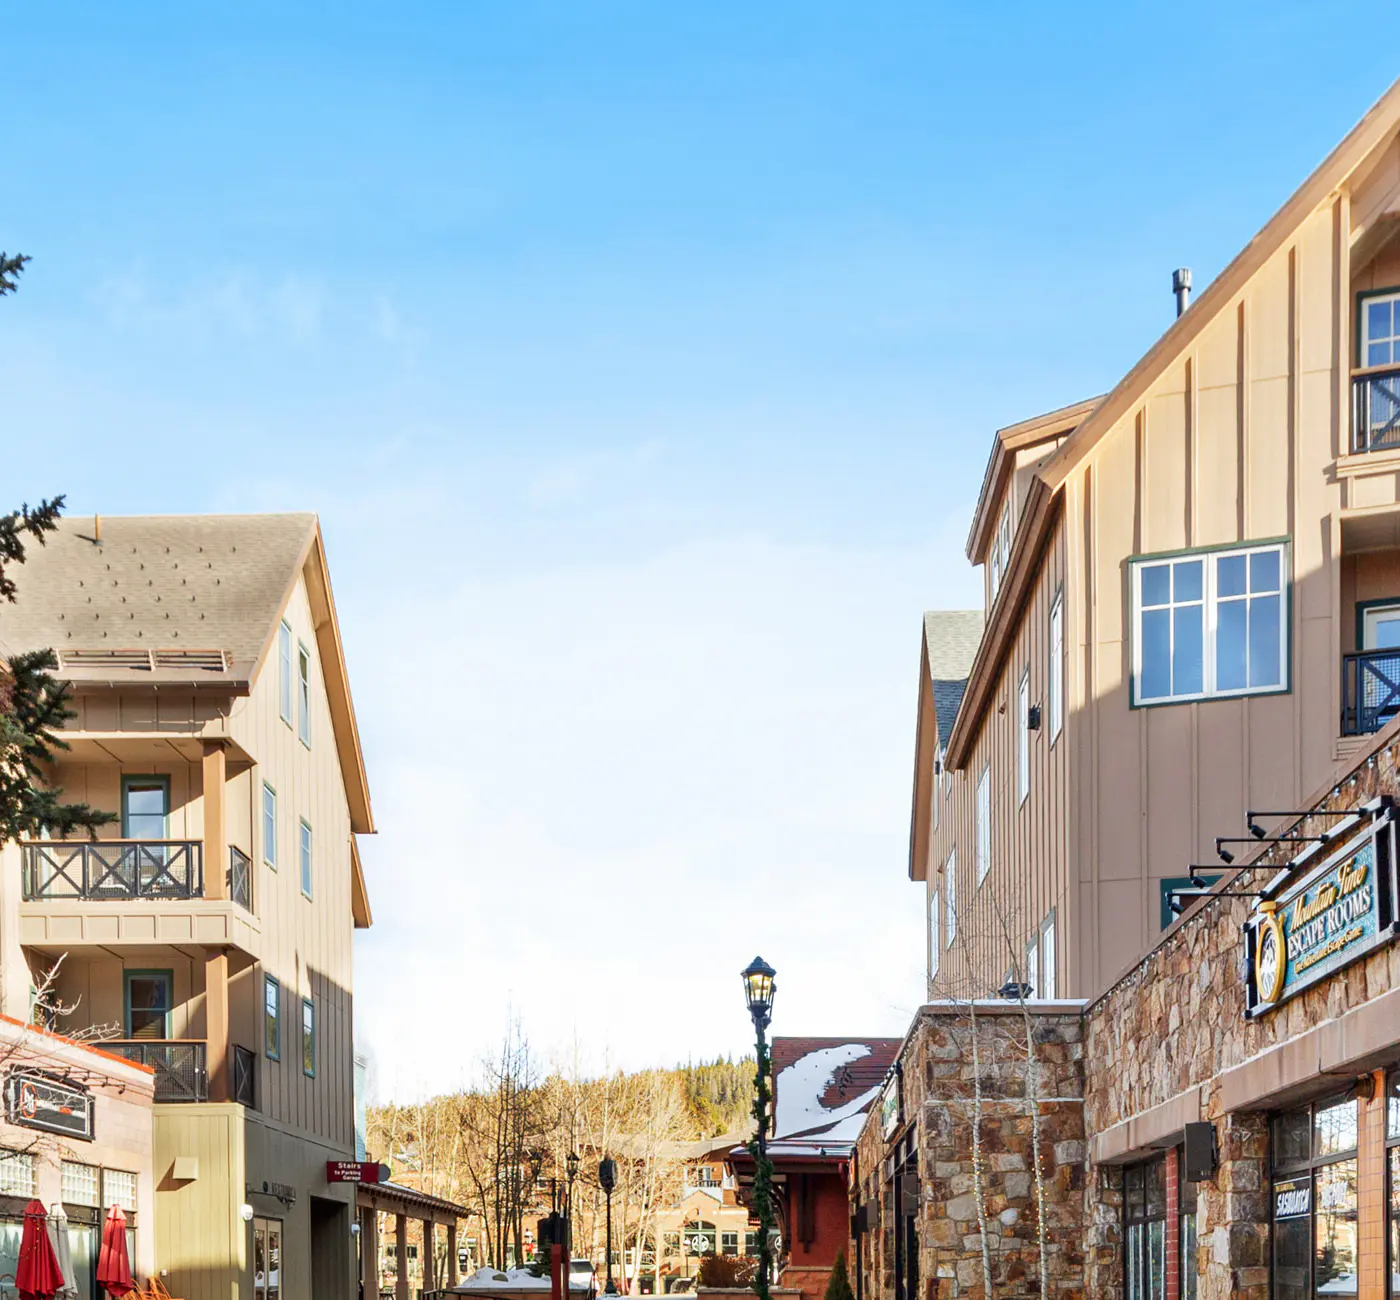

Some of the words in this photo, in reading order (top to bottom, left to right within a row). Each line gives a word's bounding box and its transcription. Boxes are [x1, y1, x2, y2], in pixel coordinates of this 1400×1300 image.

[1287, 914, 1325, 960] ESCAPE
[1328, 885, 1371, 934] ROOMS
[1289, 882, 1338, 933] Mountain
[1336, 857, 1368, 900] Time
[1276, 1188, 1310, 1216] SASQUATCH
